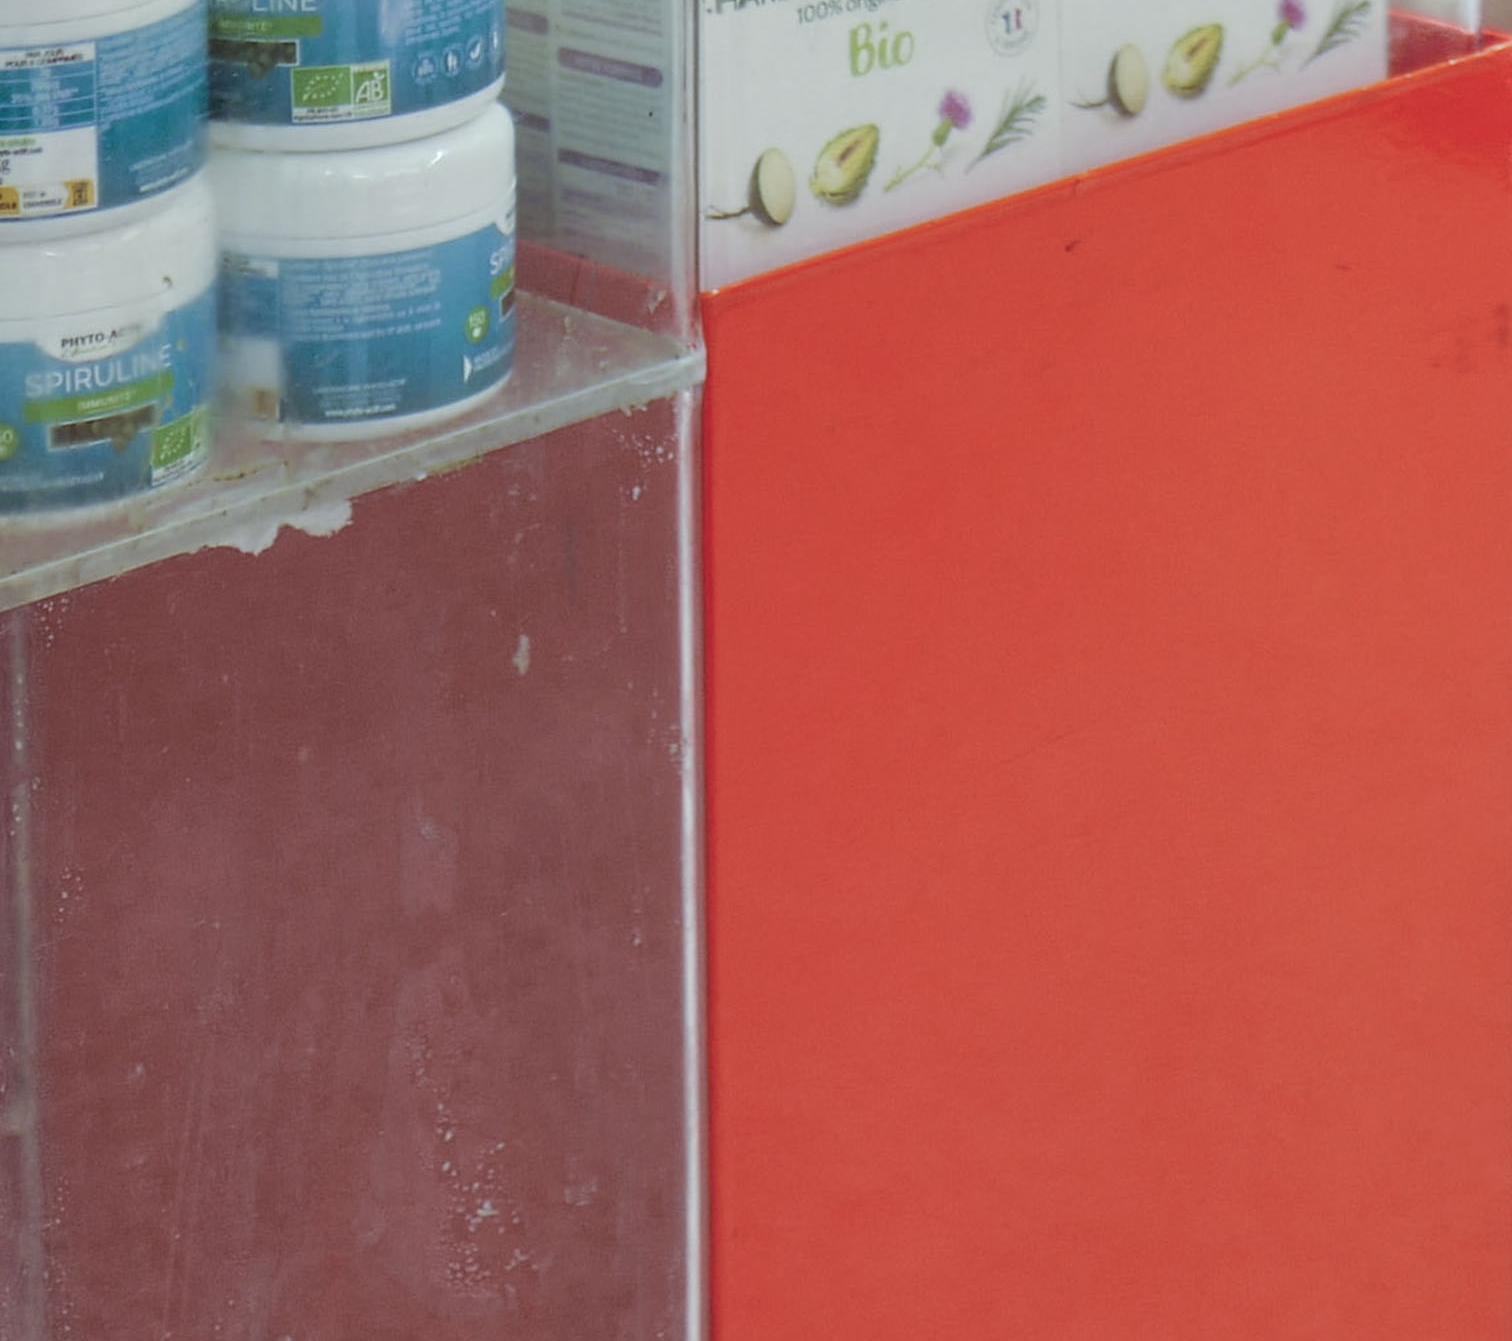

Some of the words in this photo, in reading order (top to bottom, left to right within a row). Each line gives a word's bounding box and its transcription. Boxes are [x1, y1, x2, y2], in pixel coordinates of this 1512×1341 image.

[796, 0, 844, 26] 100%
[846, 22, 916, 80] Bio
[25, 343, 172, 399] SPIRULINE
